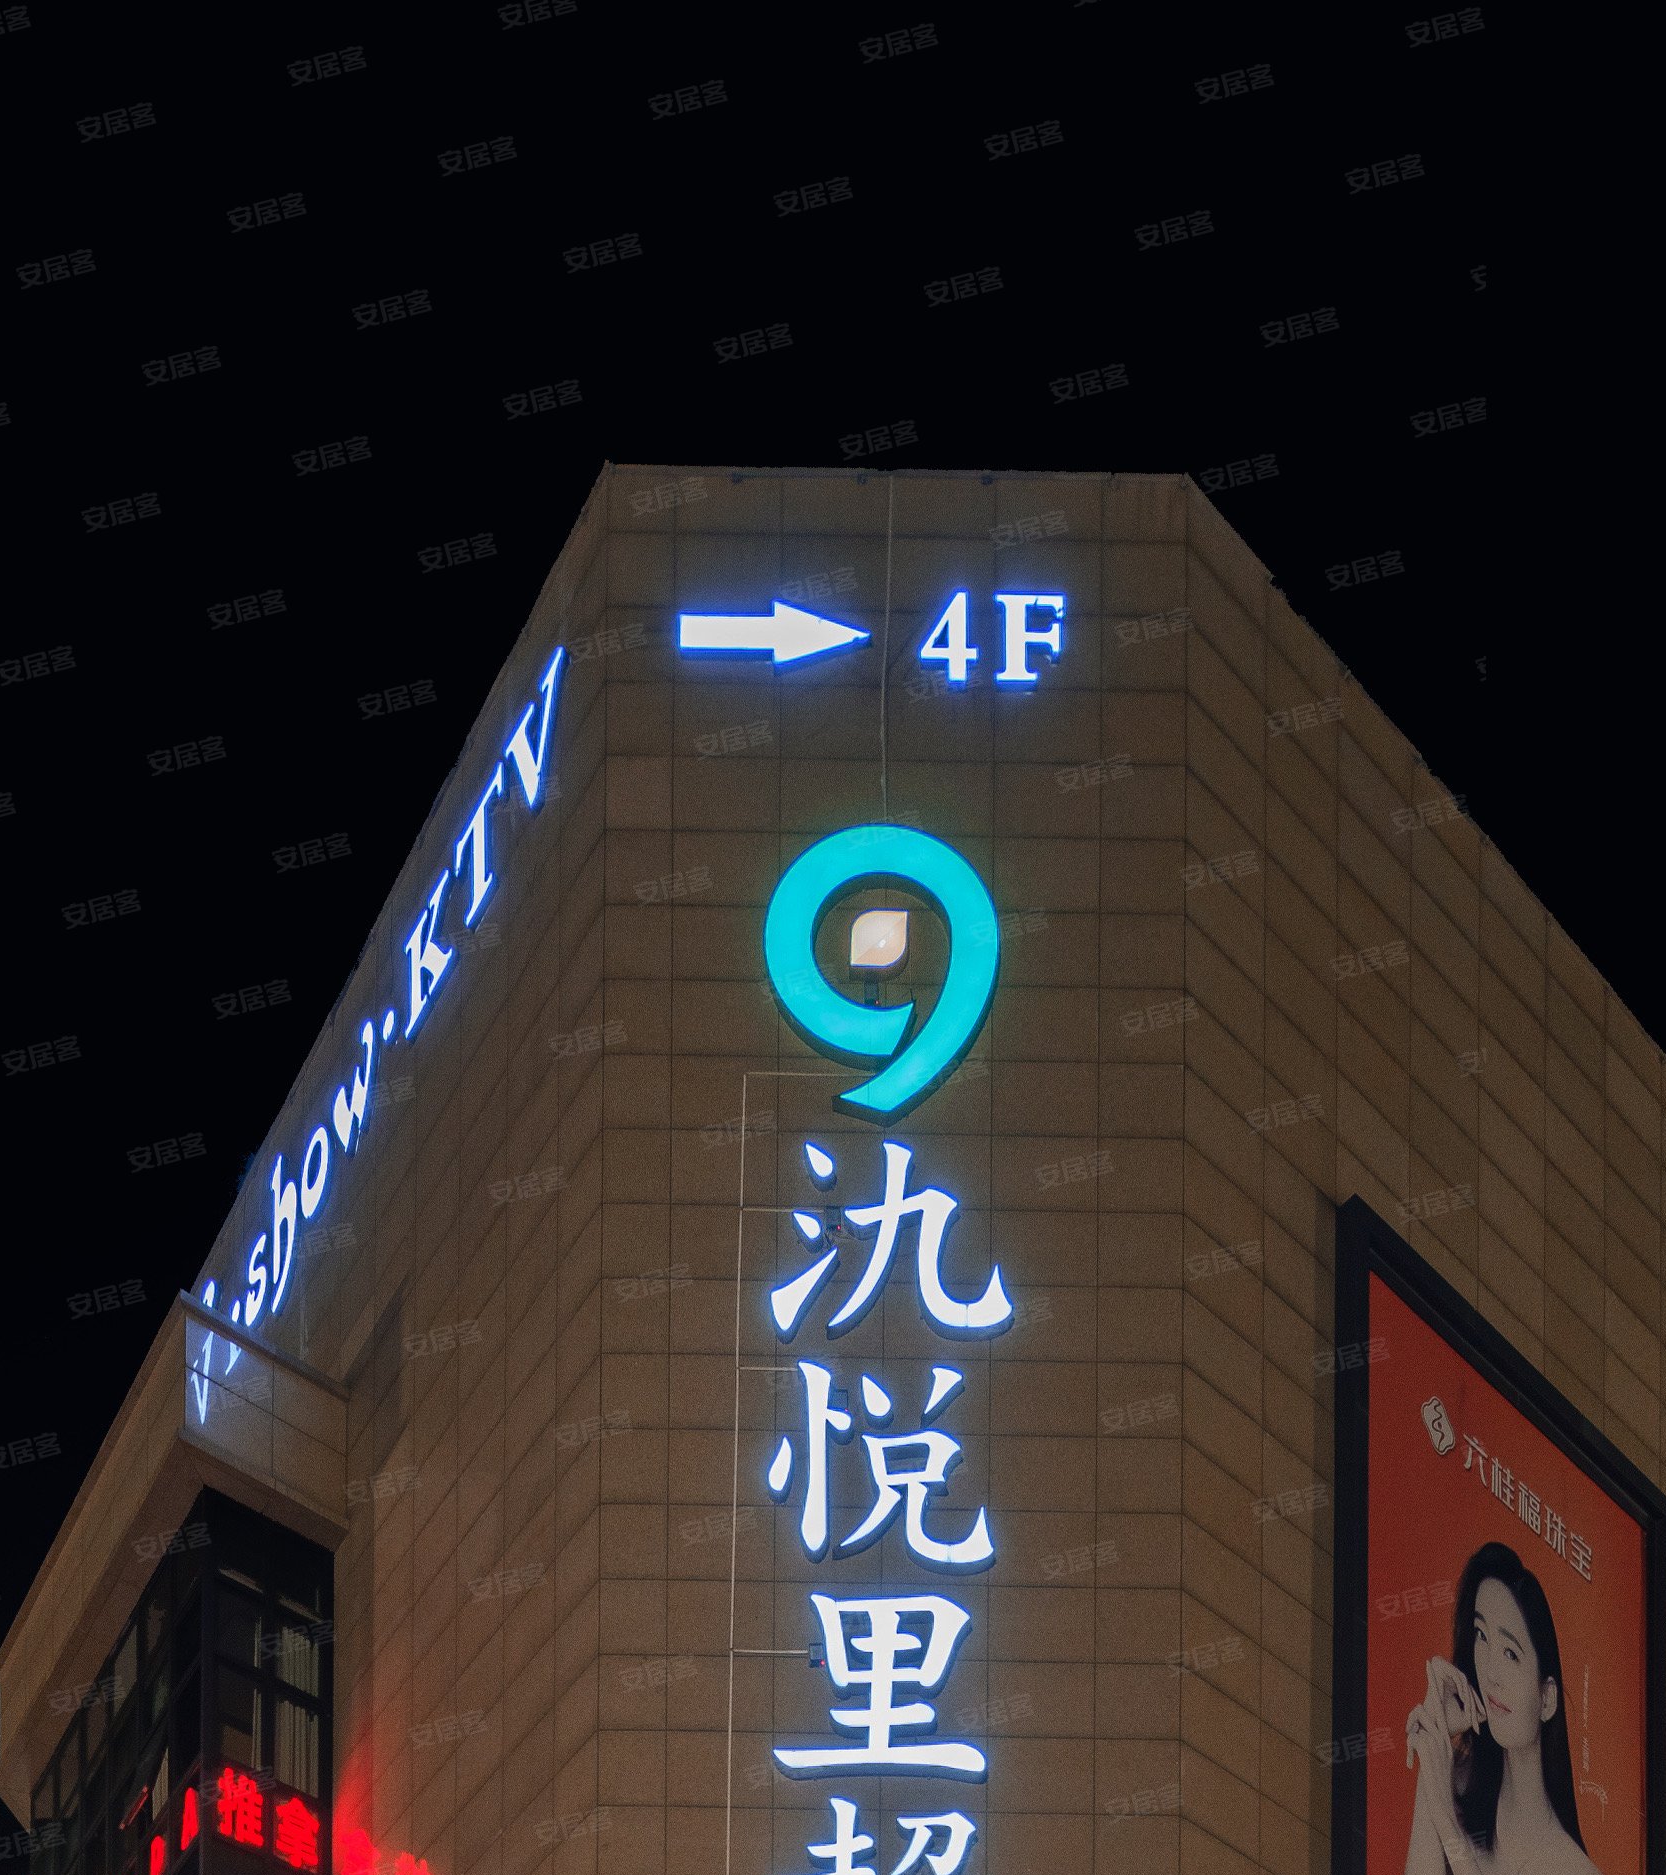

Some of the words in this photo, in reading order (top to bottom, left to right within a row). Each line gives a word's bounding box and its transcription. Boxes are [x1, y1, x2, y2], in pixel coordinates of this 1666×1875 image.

[919, 590, 1065, 683] 4F
[1463, 1432, 1593, 1582] 六桂福珠宝
[217, 1767, 320, 1868] 推拿
